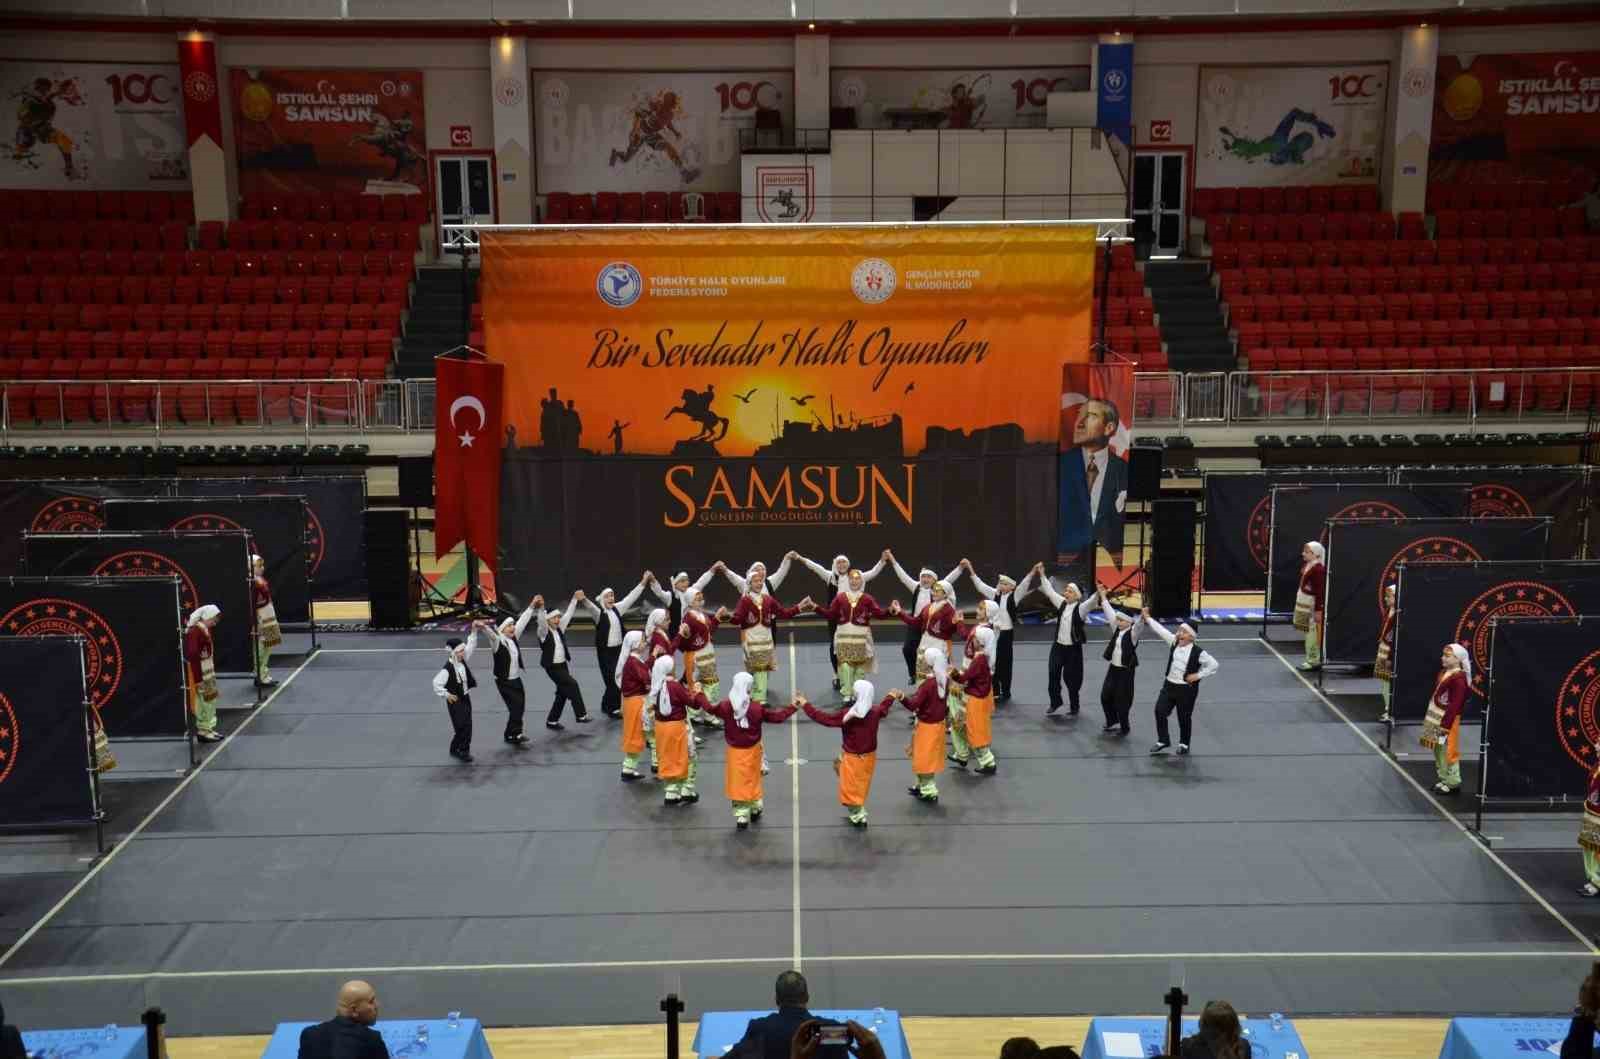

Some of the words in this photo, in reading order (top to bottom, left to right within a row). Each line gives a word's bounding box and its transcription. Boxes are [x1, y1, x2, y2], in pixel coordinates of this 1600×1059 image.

[285, 105, 372, 122] SAMSUN
[452, 129, 472, 143] C3
[1151, 124, 1171, 138] C2
[699, 275, 728, 285] HALK
[730, 274, 785, 286] OYUNLARI
[649, 287, 728, 297] FEDERASYONU
[585, 327, 641, 369] Bir
[640, 319, 776, 369] Sevdadır
[778, 319, 858, 367] Halk
[858, 317, 990, 393] Oyunları
[663, 463, 918, 528] SAMSUN
